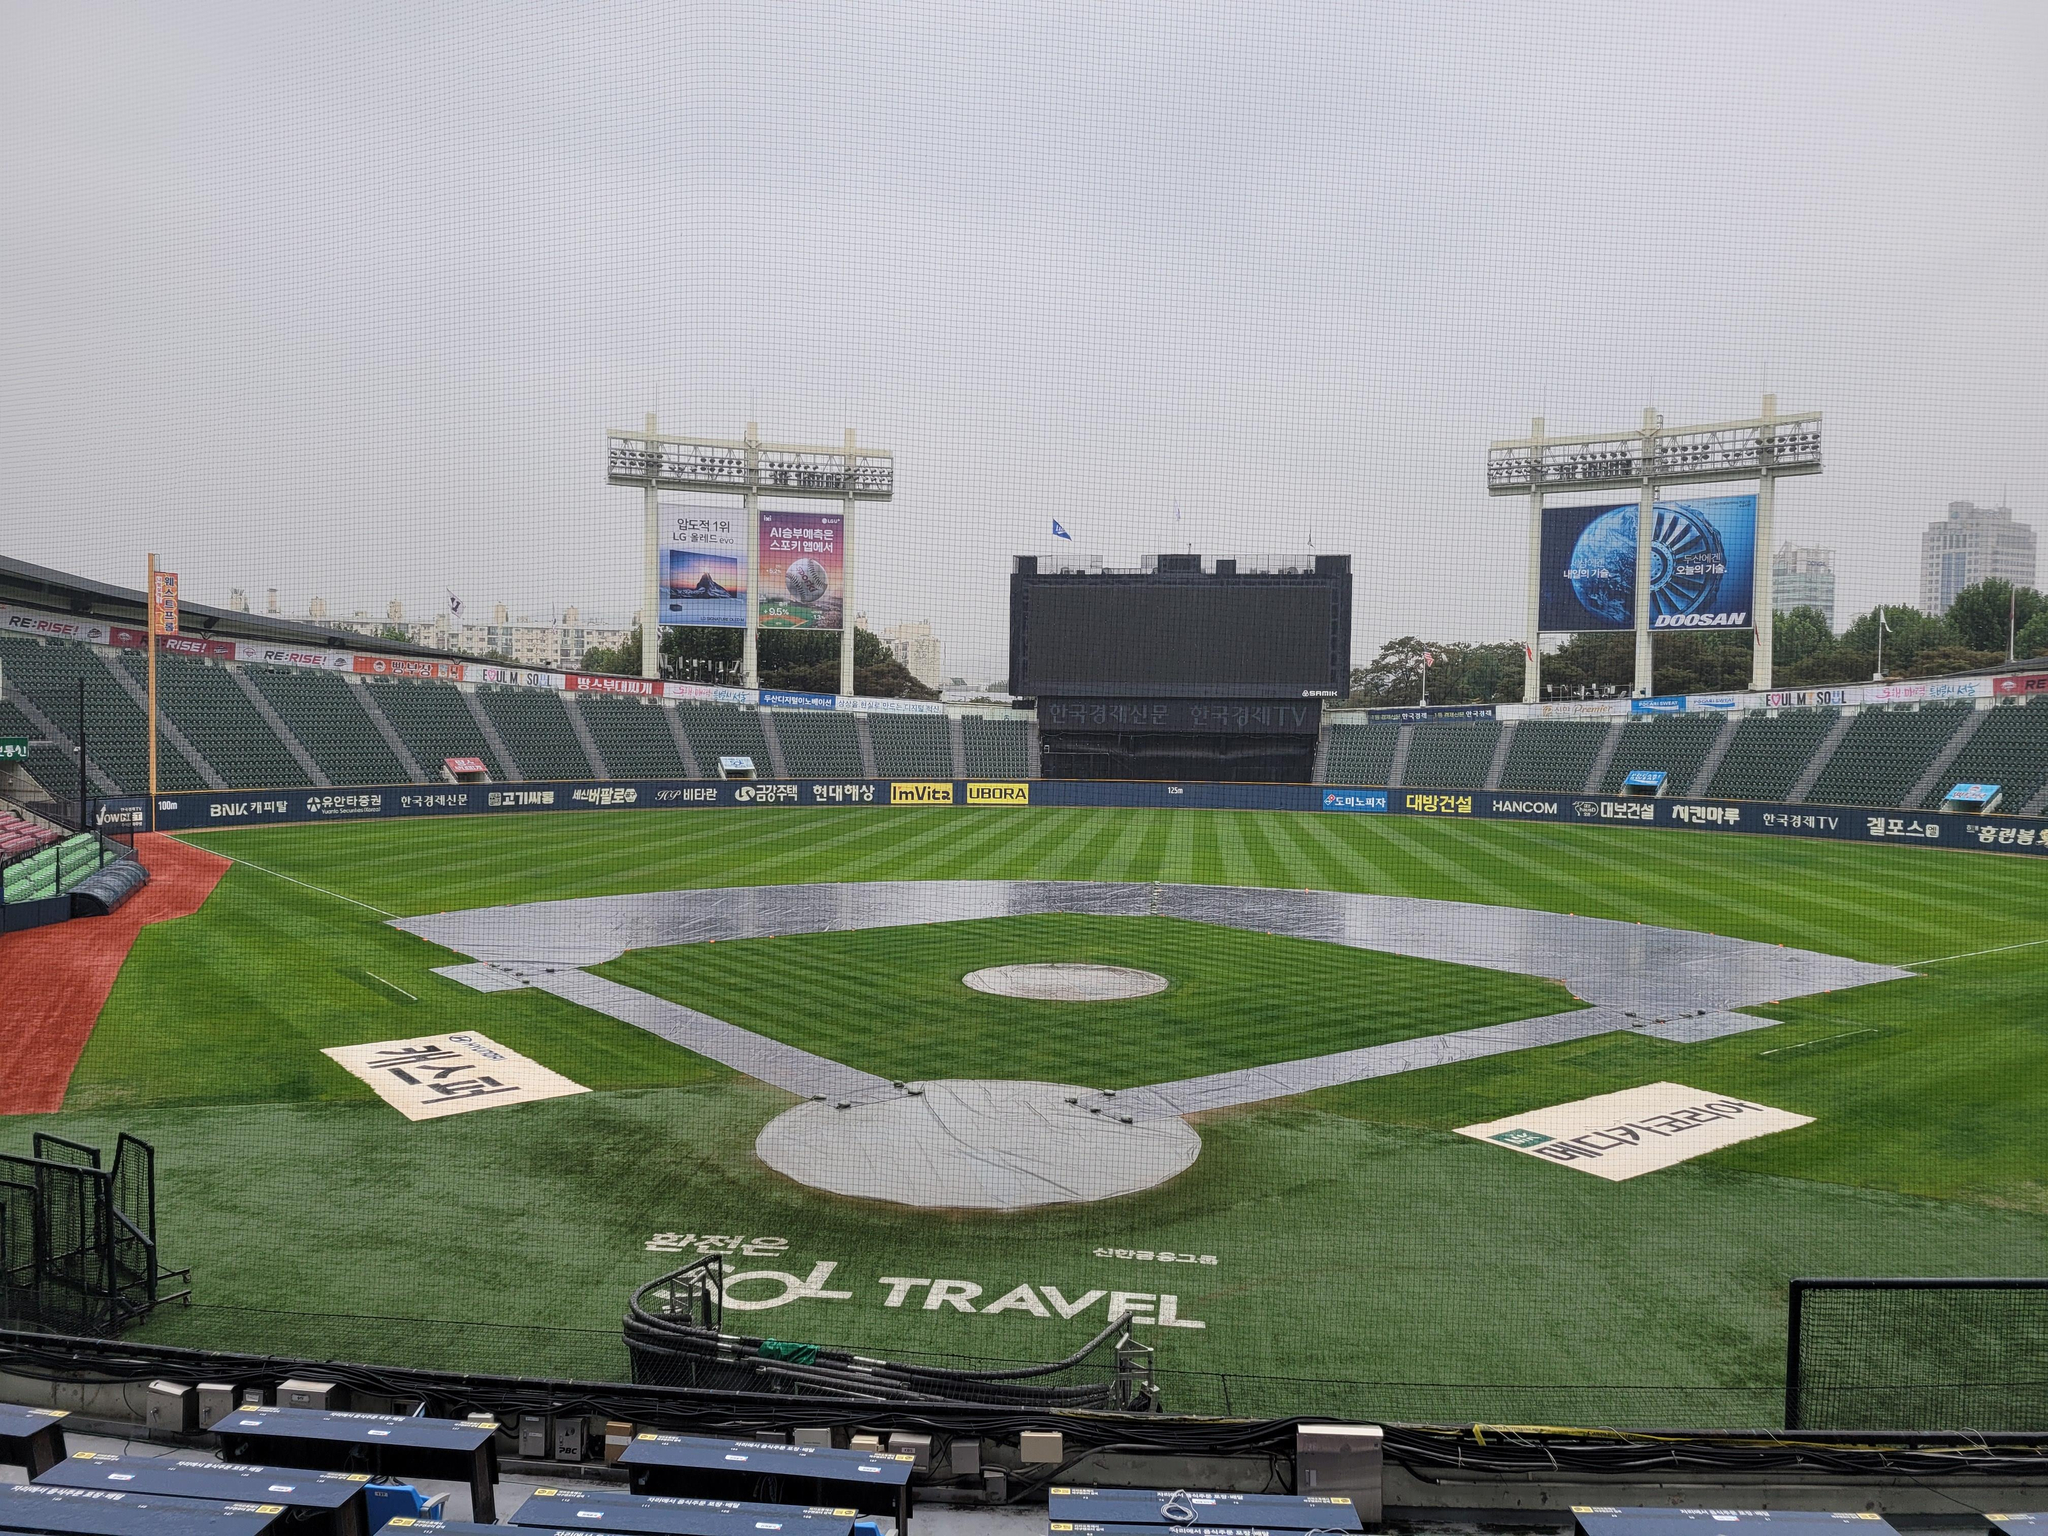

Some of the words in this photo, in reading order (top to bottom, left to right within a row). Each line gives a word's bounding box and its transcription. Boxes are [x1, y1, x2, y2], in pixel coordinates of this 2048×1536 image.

[677, 518, 710, 532] 압도적
[712, 520, 730, 533] 1위
[673, 532, 687, 541] LG
[690, 532, 718, 543] 올레드
[719, 537, 734, 545] evo
[770, 527, 834, 541] AI승부예측은
[770, 540, 801, 552] 스포키
[802, 541, 833, 553] 앱에서
[1684, 553, 1722, 564] 두산에겐
[1563, 568, 1590, 579] 내일의
[1590, 568, 1612, 578] 기술.
[1676, 564, 1704, 575] 오늘의
[1705, 563, 1728, 573] 기술.
[8, 616, 79, 635] RE:RISE!
[1655, 612, 1747, 627] DOOSAN
[264, 650, 327, 665] RE:RISE!
[577, 677, 653, 695] 땅스부대찌개
[1929, 684, 1955, 698] 특별시
[1957, 682, 1980, 695] 서울
[732, 692, 750, 702] 서울
[763, 694, 832, 707] 두산디지털이노베이션
[1816, 690, 1847, 705] SOUL
[1050, 703, 1170, 725] 한국경제신문
[1190, 706, 1307, 727] 한국경제TV
[1572, 704, 1613, 714] Premier
[572, 787, 625, 805] 세신버팔로
[683, 788, 718, 801] 비타란
[756, 784, 798, 802] 금강주택
[813, 784, 875, 802] 현대해상
[969, 787, 1027, 799] UBORA
[1167, 786, 1184, 794] 125m
[158, 801, 178, 811] 100m
[322, 794, 382, 808] 유안타증권
[401, 793, 469, 808] 한국경제신문
[1335, 796, 1387, 808] 도미노피자
[1406, 794, 1472, 813] 대방건설
[1492, 800, 1558, 814] HANCOM
[210, 803, 249, 817] BNK
[250, 801, 288, 814] 캐피탈
[1601, 802, 1654, 820] 대보건설
[1672, 805, 1741, 825] 치킨마루
[1763, 812, 1839, 830] 한국경제TV
[462, 1040, 508, 1063] HYUNDAI
[365, 1045, 522, 1105] 캐스퍼
[1528, 1099, 1764, 1161] 메디카코리아
[644, 1232, 790, 1257] 환전은
[1092, 1247, 1219, 1266] 신한금융그룹
[877, 1276, 1206, 1329] TRAVEL
